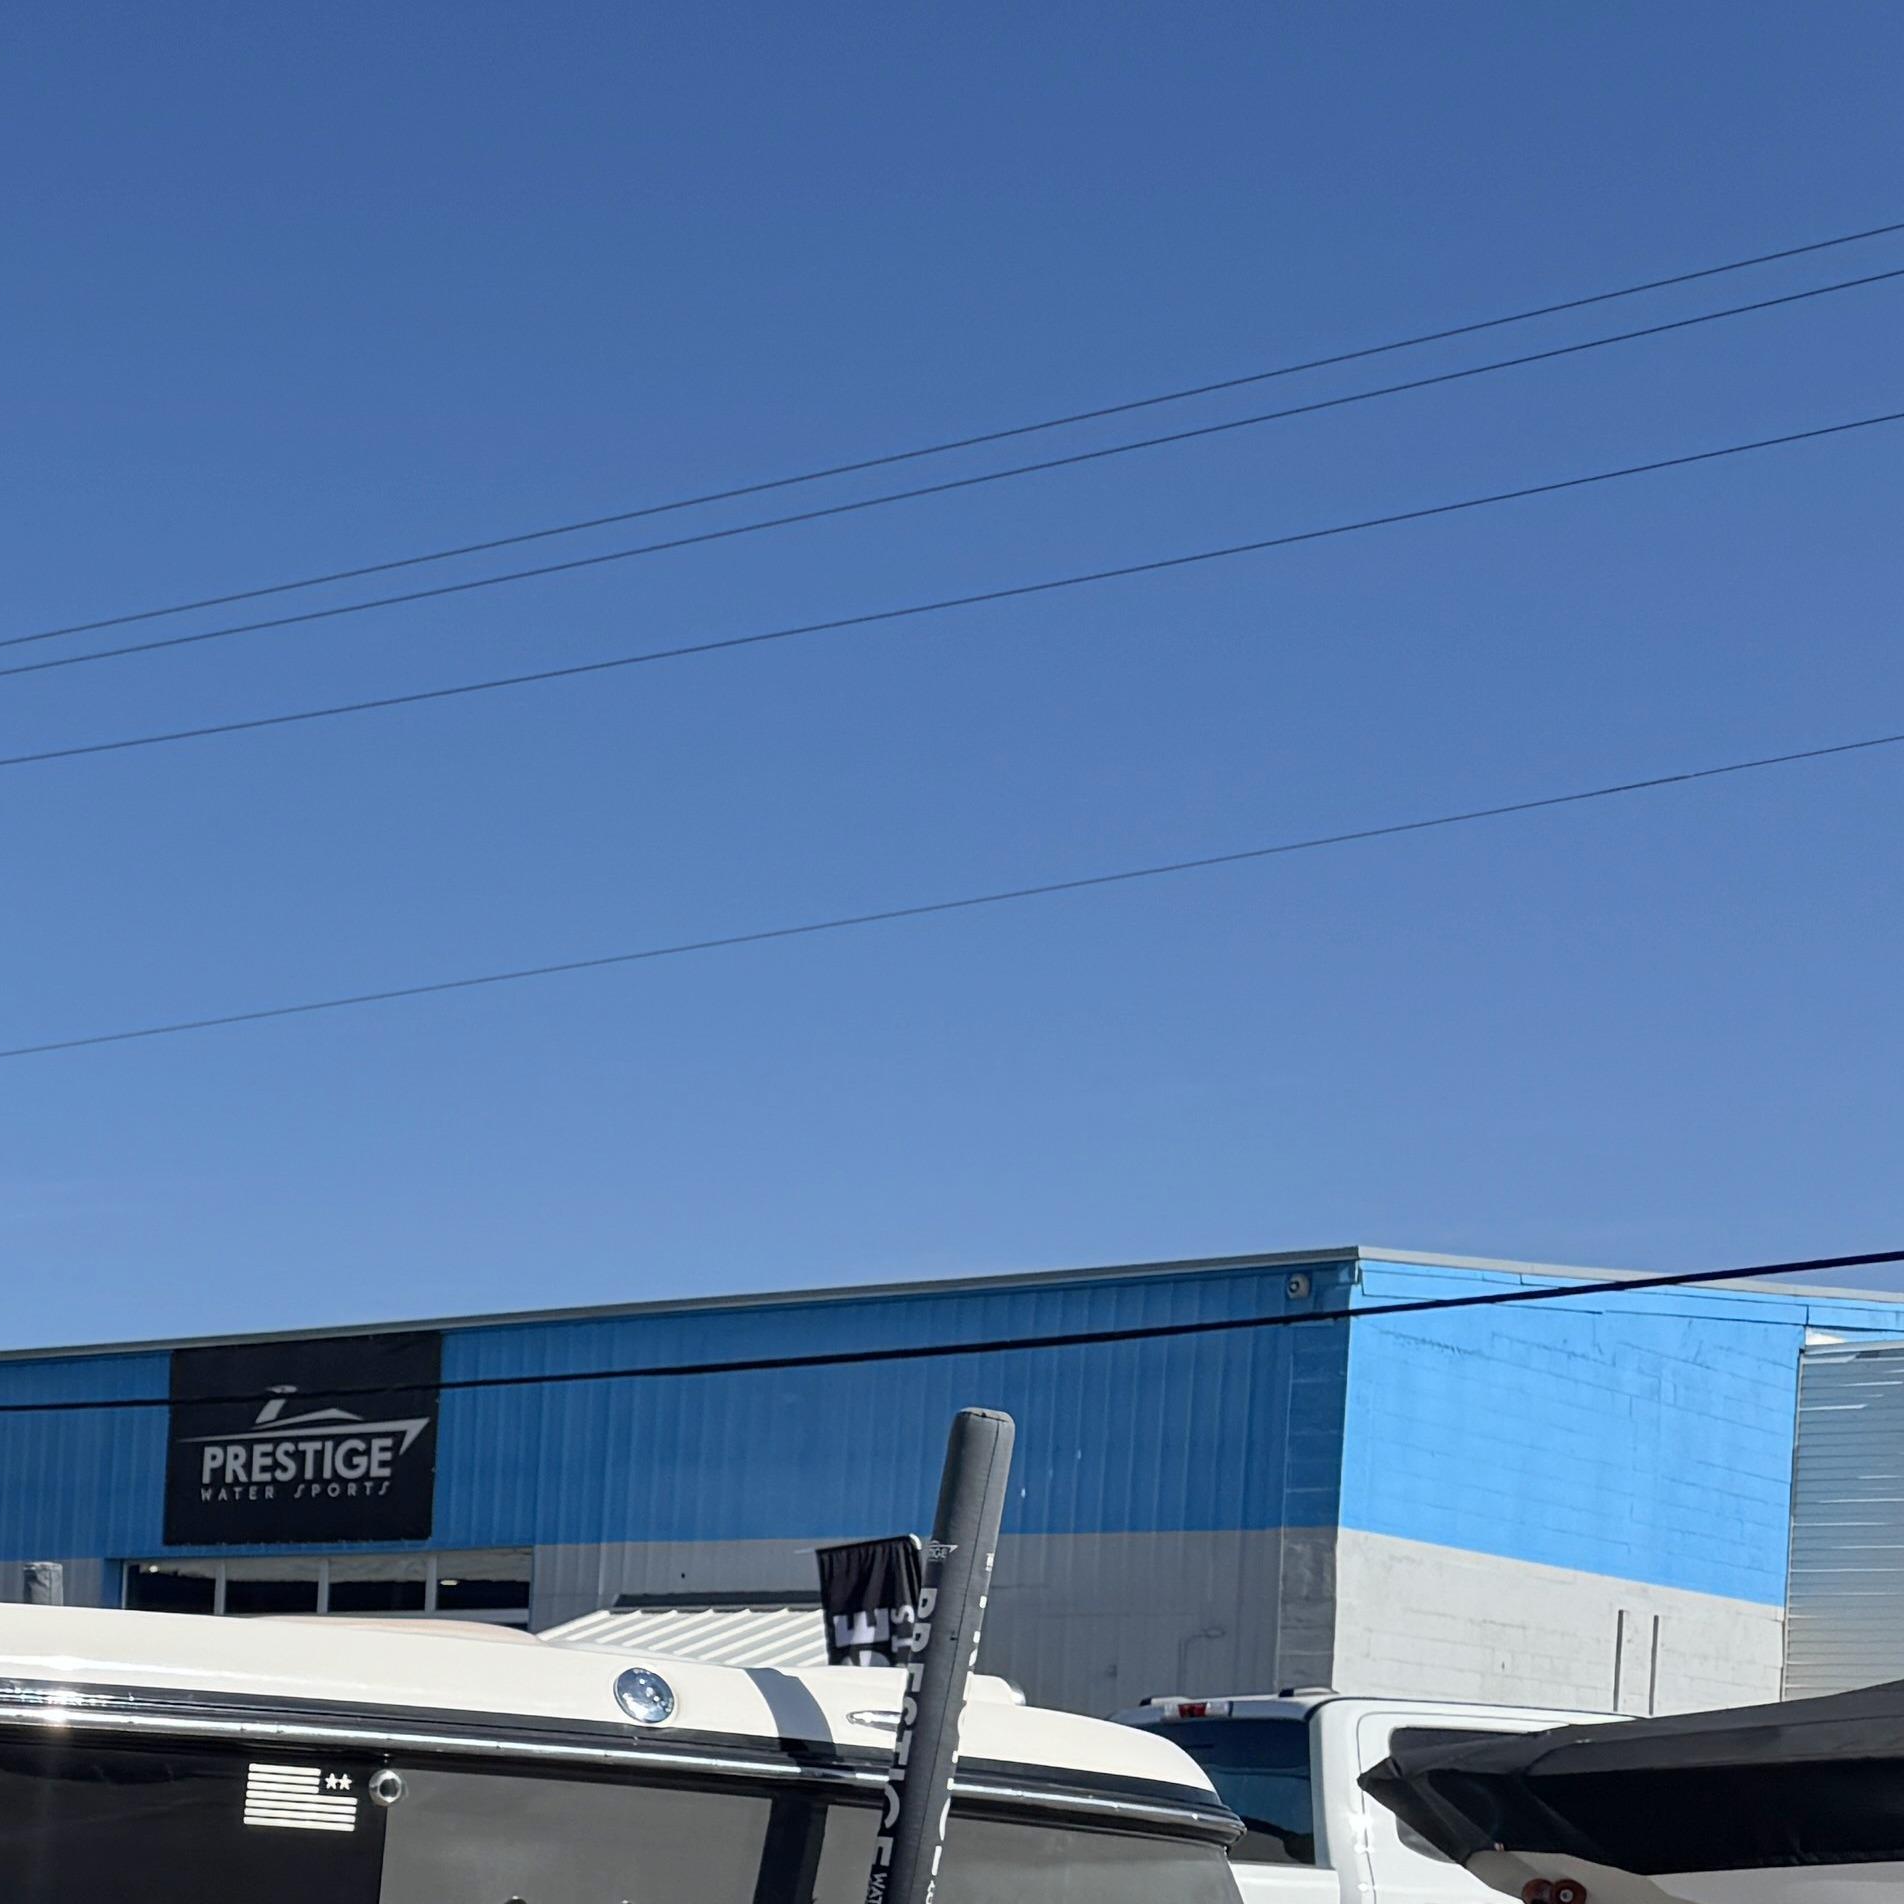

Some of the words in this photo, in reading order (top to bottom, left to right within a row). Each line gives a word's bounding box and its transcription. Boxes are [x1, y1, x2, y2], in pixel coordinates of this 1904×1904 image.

[201, 1438, 394, 1484] PRESTIGE
[201, 1485, 274, 1501] WATER
[294, 1481, 391, 1499] SPORTS
